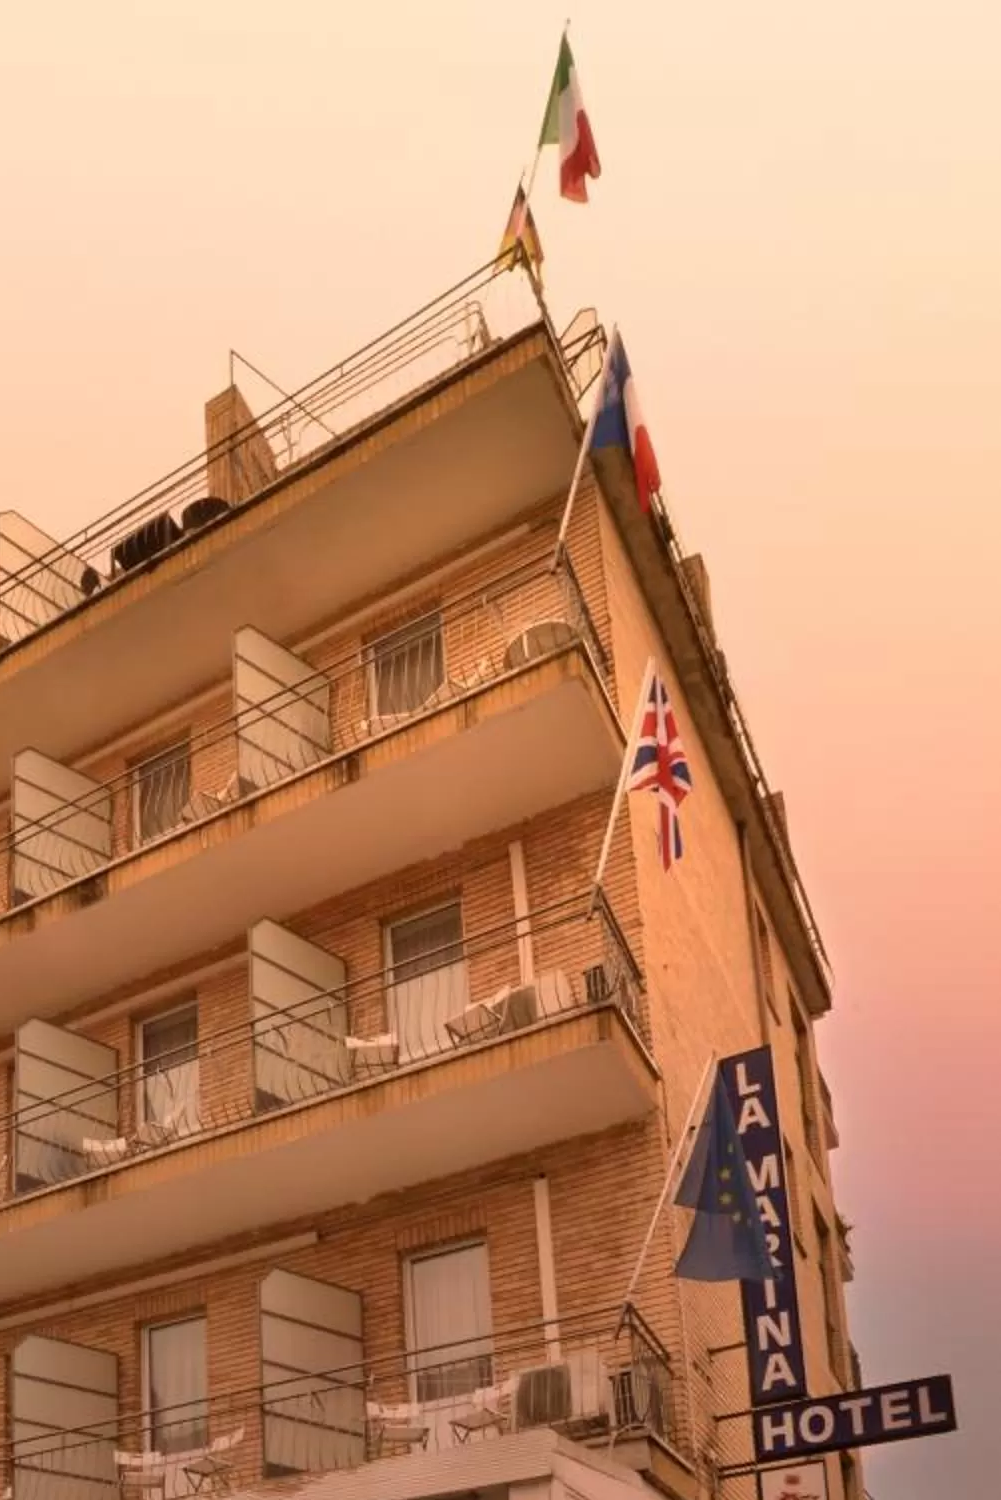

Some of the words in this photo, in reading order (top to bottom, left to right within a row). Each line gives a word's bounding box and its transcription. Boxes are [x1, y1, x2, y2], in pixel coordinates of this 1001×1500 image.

[735, 1062, 772, 1135] LA
[745, 1153, 797, 1393] MARINA
[761, 1385, 948, 1453] HOTEL
